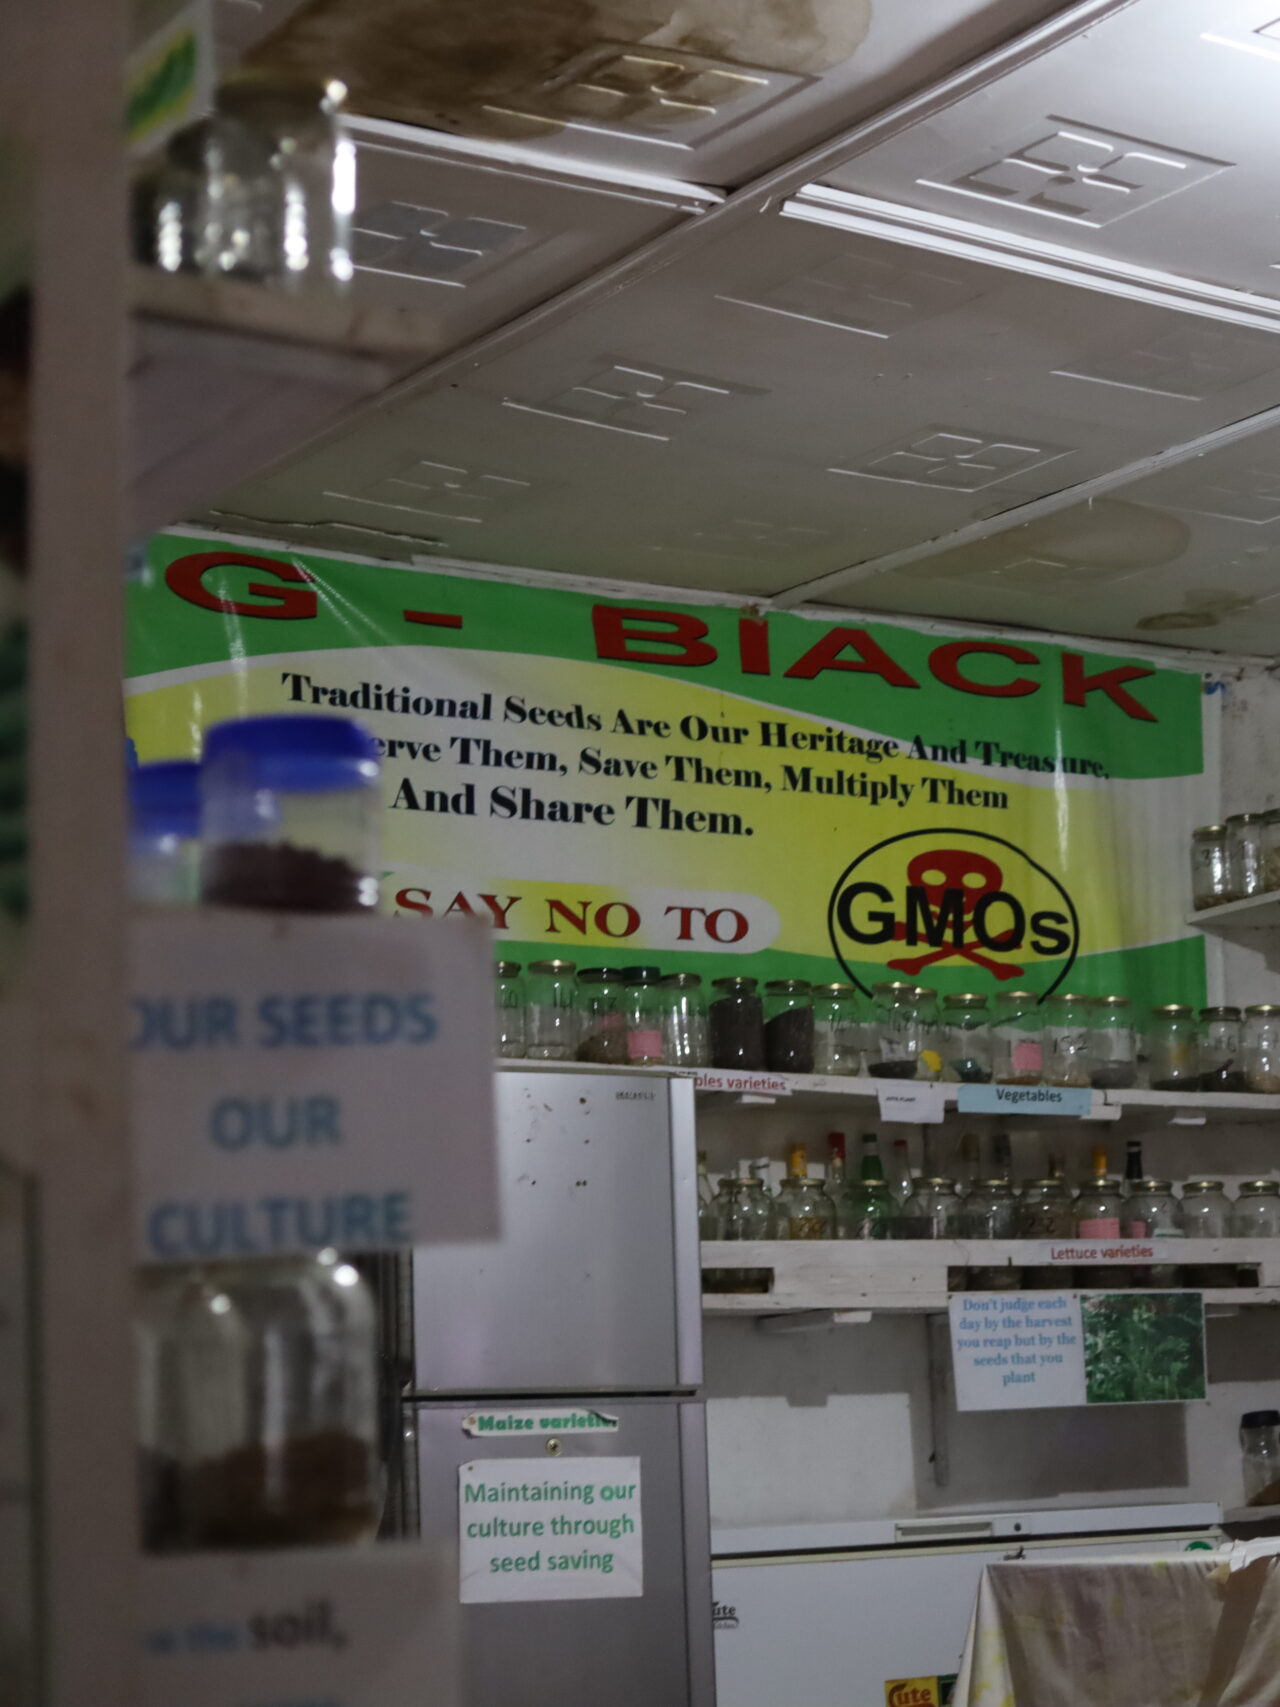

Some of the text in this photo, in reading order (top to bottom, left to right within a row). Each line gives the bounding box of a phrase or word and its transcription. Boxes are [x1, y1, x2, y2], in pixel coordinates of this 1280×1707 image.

[165, 551, 317, 620] G
[592, 604, 1159, 723] BIACK
[282, 672, 492, 721] Traditional
[504, 696, 602, 733] Seeds
[612, 709, 671, 739] Are
[680, 716, 750, 746] Our
[759, 721, 900, 764] Heritage
[907, 735, 968, 766] And
[371, 735, 1009, 810] erve Them, Save Them, Multiply Them
[389, 777, 754, 836] And Share Them.
[394, 888, 750, 944] SAY NO TO
[837, 882, 1072, 956] GMOs
[258, 992, 437, 1049] SEEDS
[727, 1077, 788, 1092] varieties
[996, 1088, 1062, 1104] Vegetables
[209, 1092, 341, 1150] OUR
[148, 1191, 412, 1258] CULTURE
[1051, 1245, 1154, 1260] Lettuce varieties
[963, 1297, 1067, 1314] Don't judge each
[960, 1315, 1072, 1332] day by the harvest
[957, 1333, 1077, 1351] you reap but by the
[974, 1352, 1063, 1367] seeds that you
[1003, 1371, 1035, 1387] plant
[478, 1415, 534, 1431] Maize
[464, 1481, 636, 1504] Maintaining our
[467, 1513, 635, 1539] culture through
[490, 1551, 614, 1573] seed saving
[711, 1602, 737, 1617] ute
[888, 1683, 931, 1707] Cute
